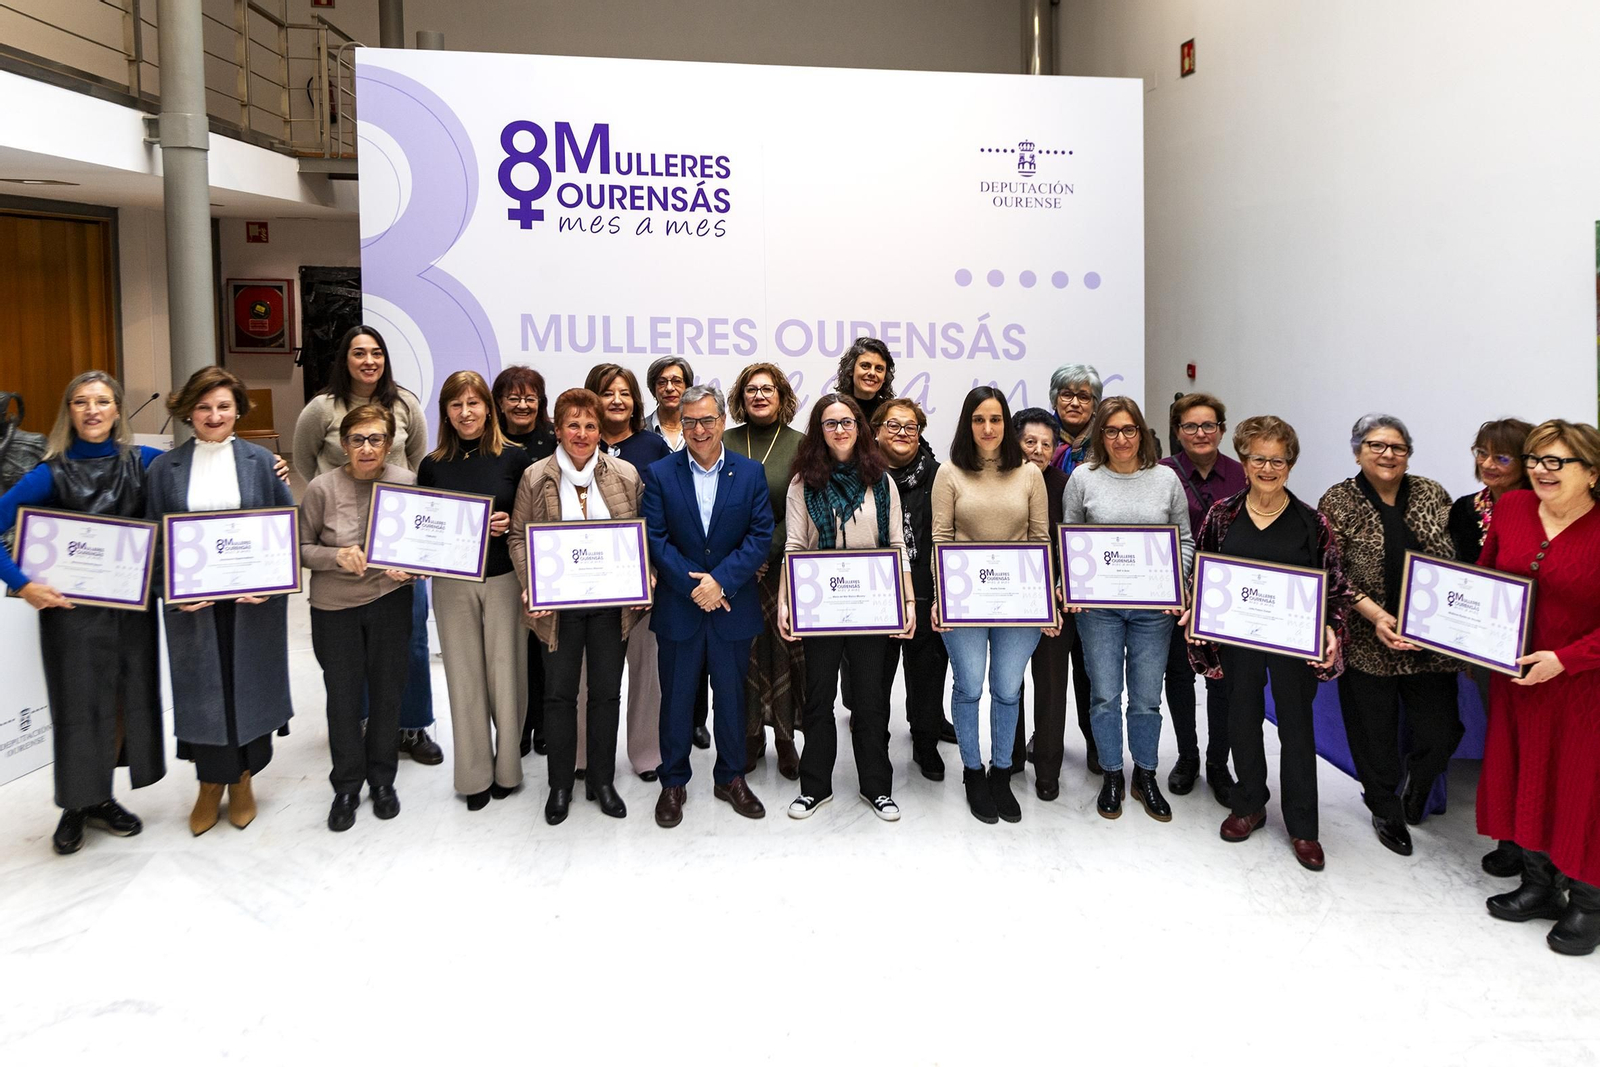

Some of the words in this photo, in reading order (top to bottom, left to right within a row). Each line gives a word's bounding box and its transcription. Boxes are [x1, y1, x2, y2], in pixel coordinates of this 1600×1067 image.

[554, 121, 731, 180] MULLERES
[498, 120, 552, 230] 8
[980, 180, 1075, 195] DEPUTACIÓN
[556, 180, 731, 214] OURENSÁS
[992, 196, 1063, 209] OURENSE
[559, 215, 621, 234] mes
[635, 217, 654, 236] a
[666, 218, 727, 238] mes
[519, 313, 758, 357] MULLERES
